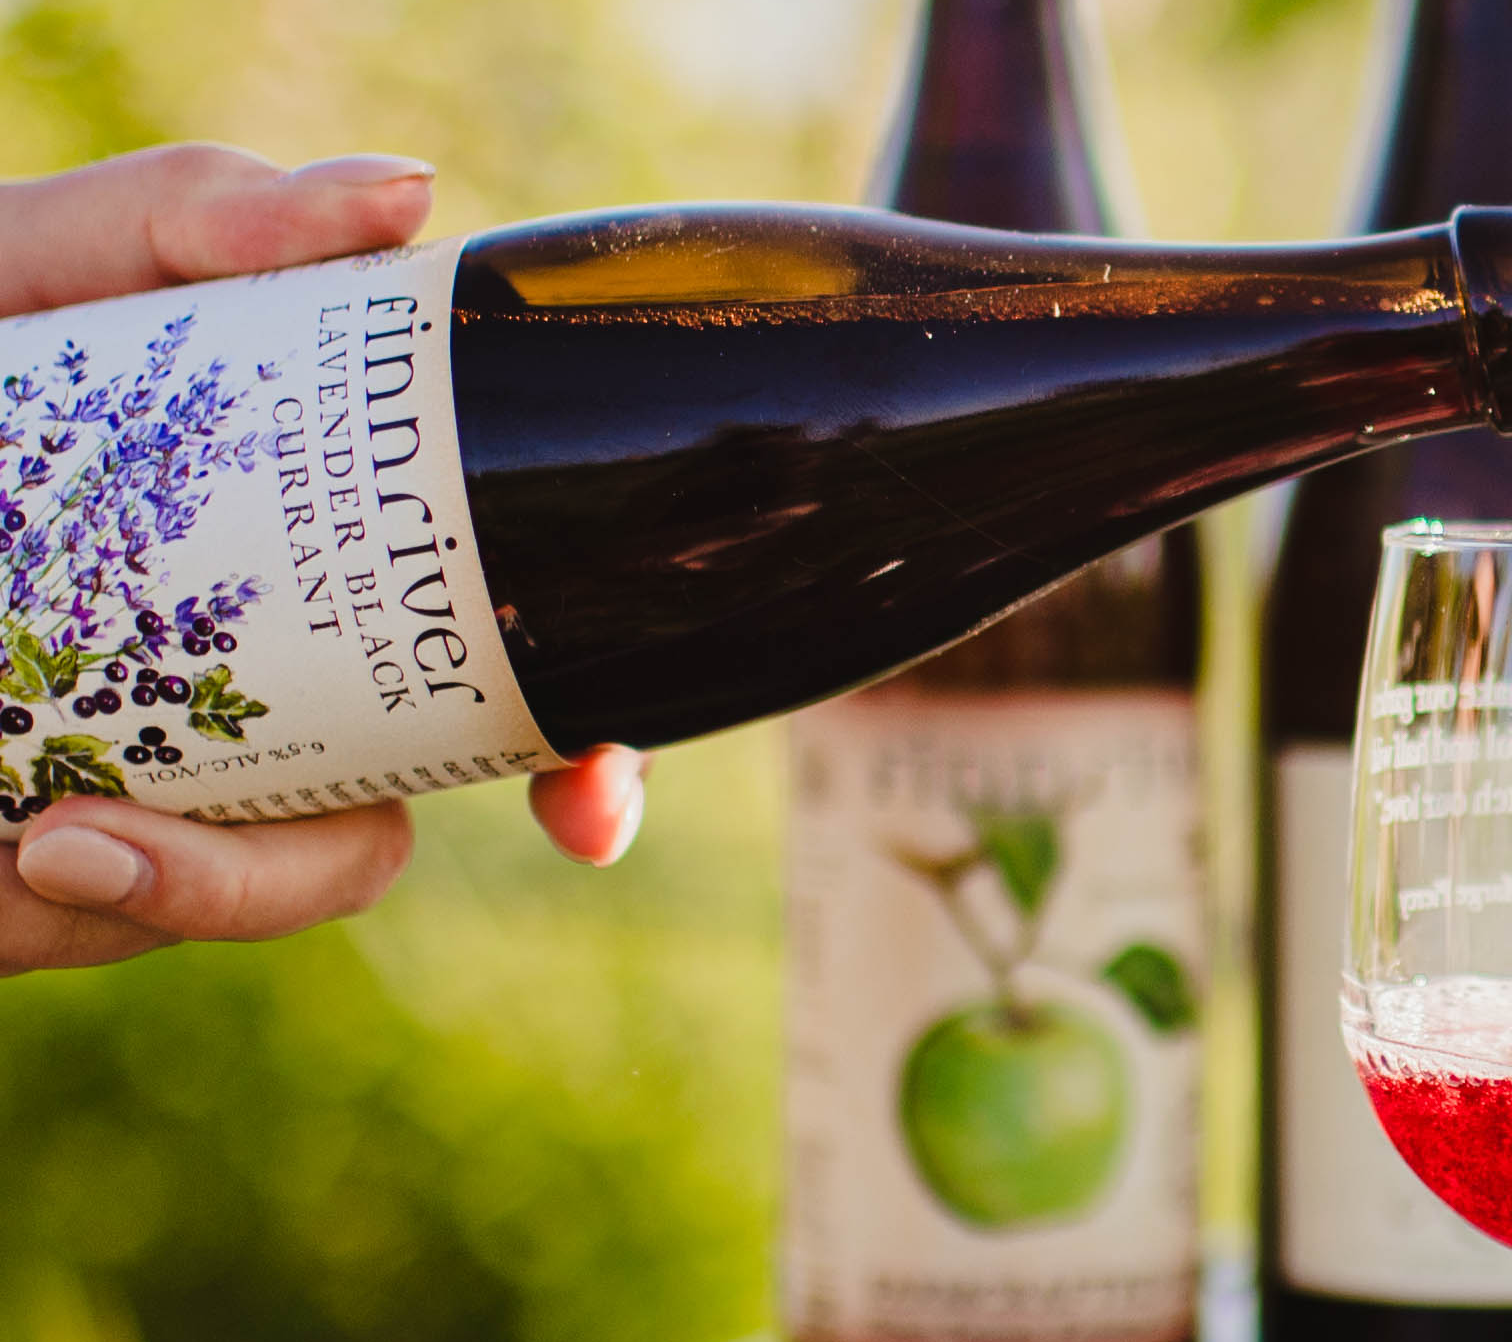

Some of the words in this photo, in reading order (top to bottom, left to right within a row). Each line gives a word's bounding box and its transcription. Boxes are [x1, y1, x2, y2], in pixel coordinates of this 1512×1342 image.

[272, 397, 342, 638] CURRANT
[318, 302, 366, 552] LAVENDER
[344, 567, 417, 713] BLACK
[364, 296, 486, 704] finnriver
[268, 741, 326, 763] 6.5%
